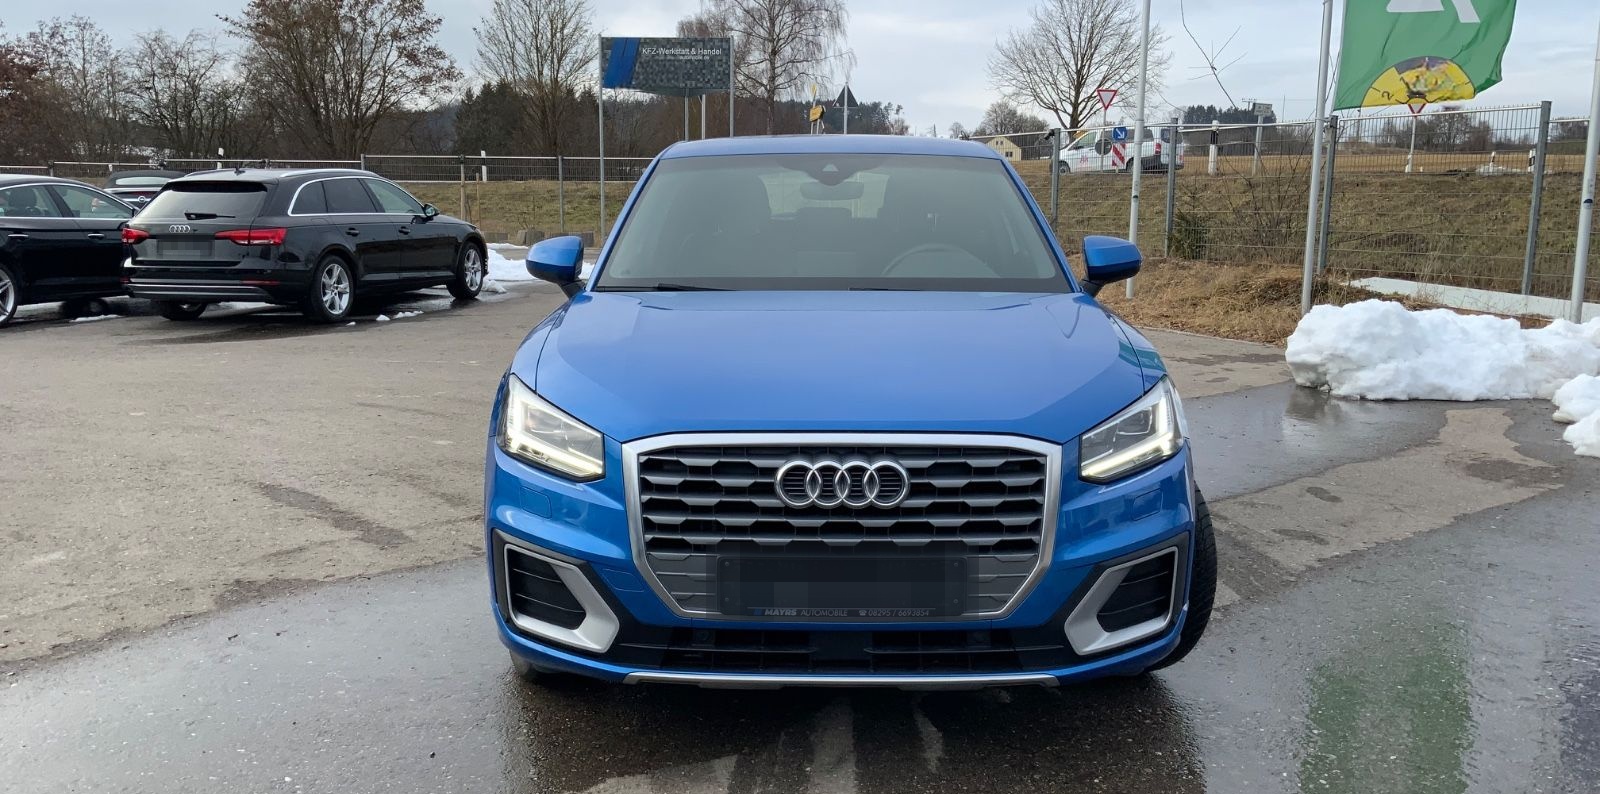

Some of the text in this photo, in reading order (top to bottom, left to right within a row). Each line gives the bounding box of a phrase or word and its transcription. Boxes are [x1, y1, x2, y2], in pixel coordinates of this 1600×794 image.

[764, 608, 798, 616] MAYRS
[800, 609, 848, 617] AUTOMOBILE
[868, 609, 891, 617] 08295
[898, 609, 930, 617] 6693854
